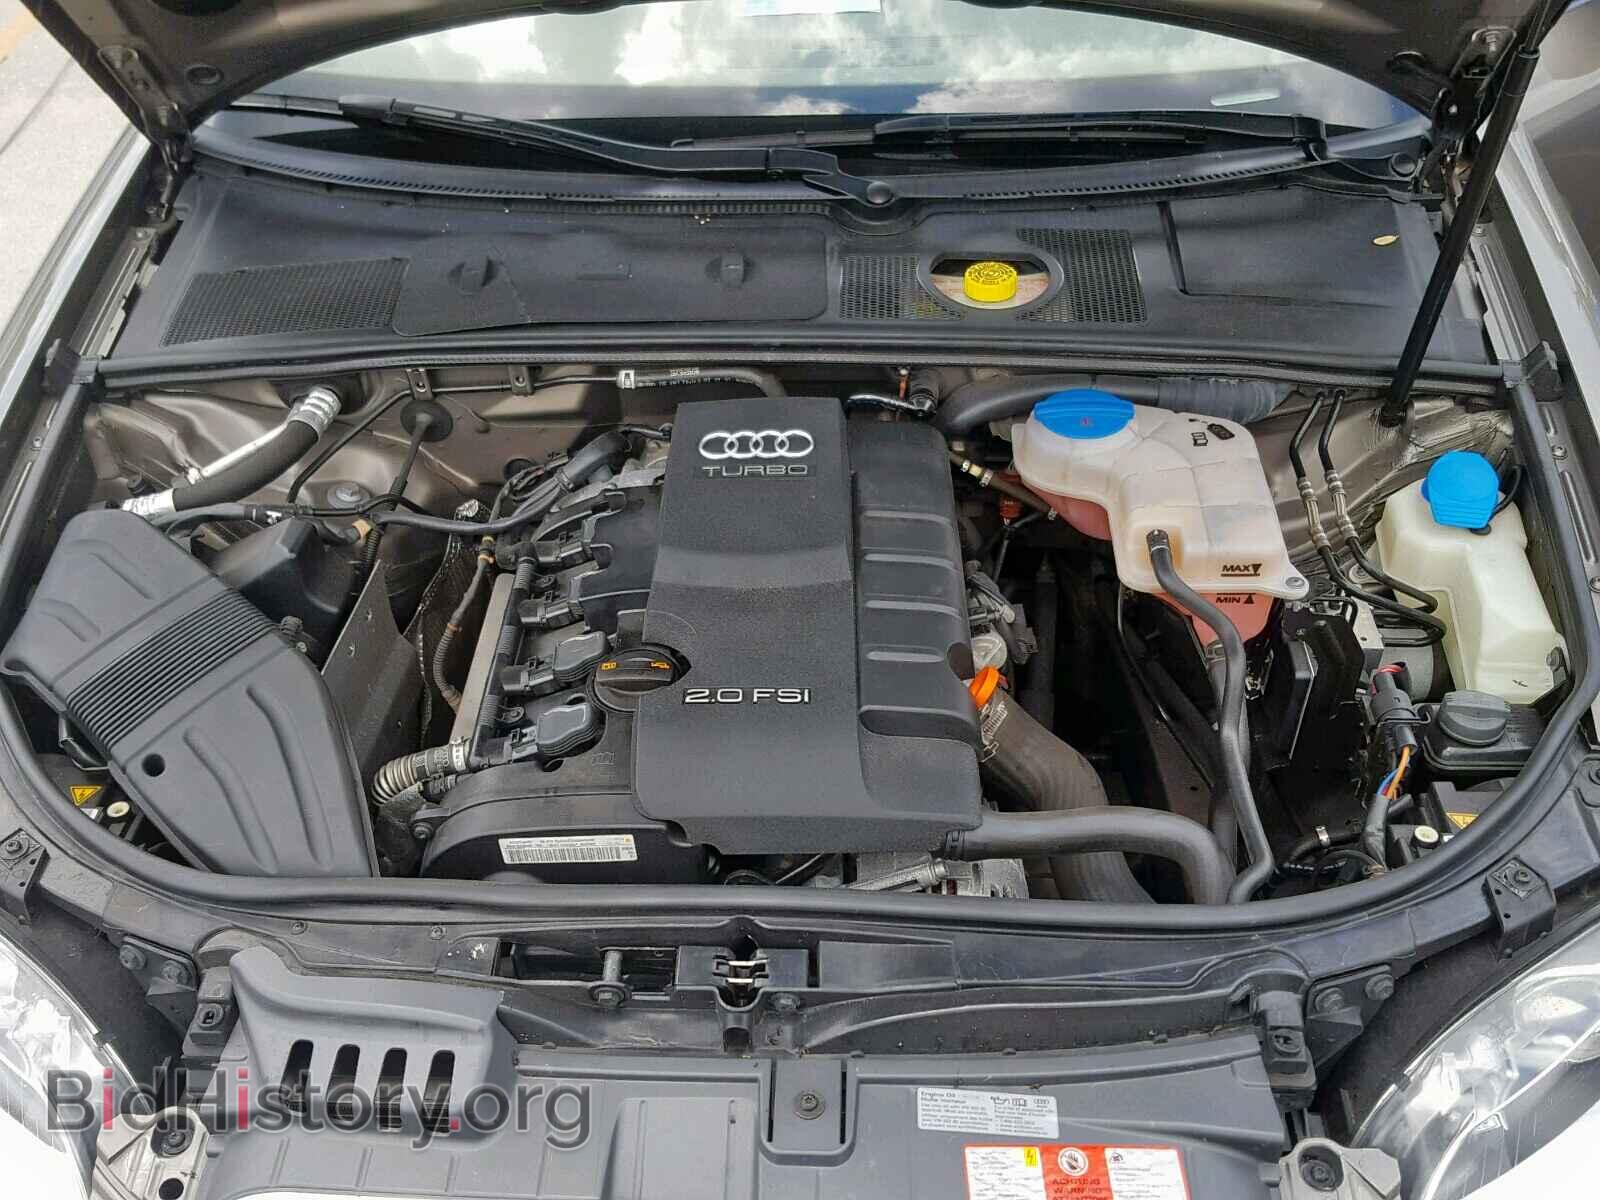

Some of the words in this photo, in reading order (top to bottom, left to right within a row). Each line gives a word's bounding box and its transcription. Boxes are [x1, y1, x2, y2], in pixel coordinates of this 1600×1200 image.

[703, 464, 807, 477] TURBO
[1222, 564, 1251, 573] MAX
[1216, 596, 1241, 604] MIN
[684, 689, 743, 704] 2.0
[752, 689, 809, 704] FSI
